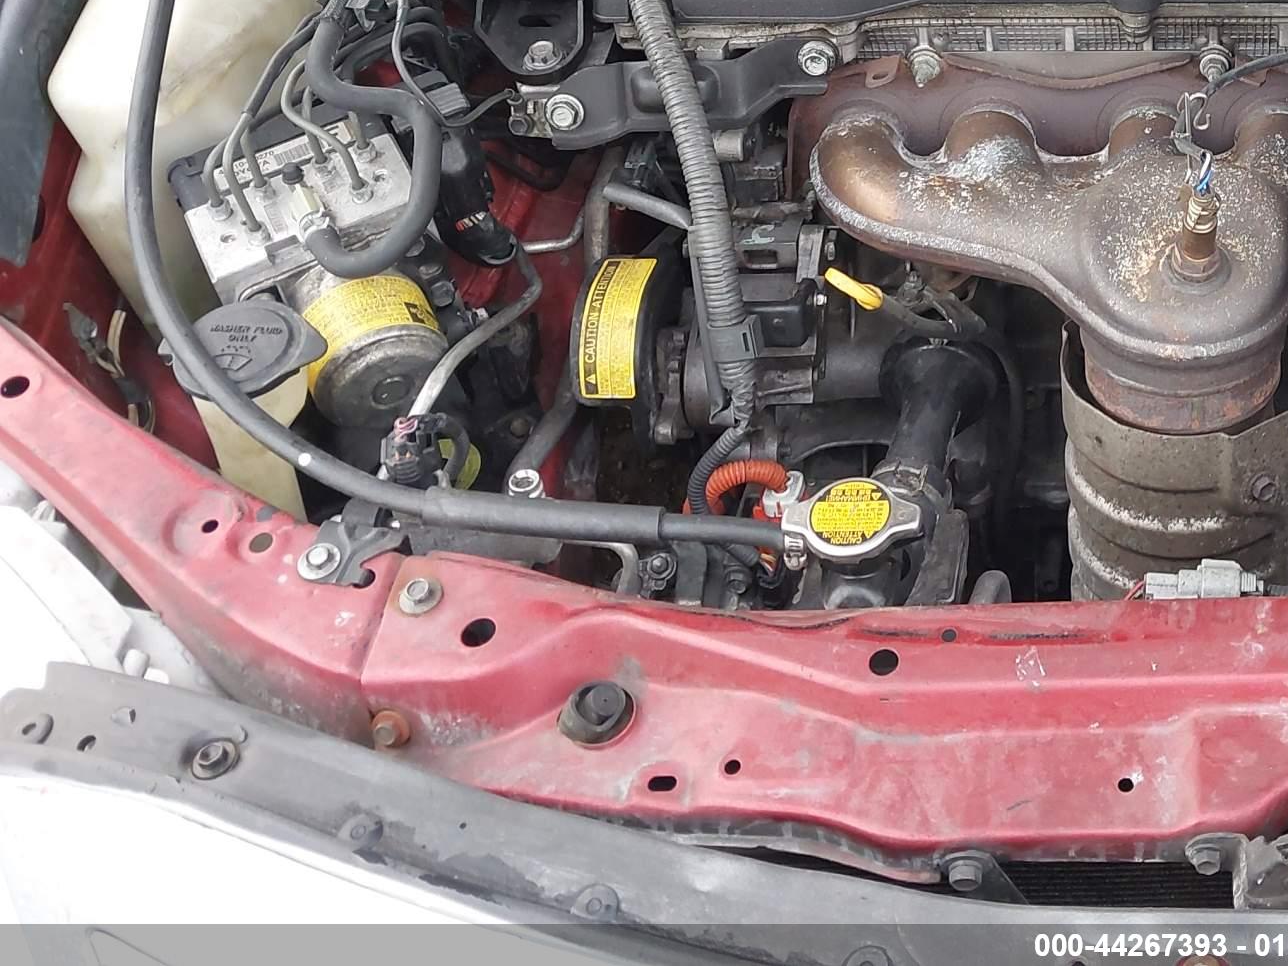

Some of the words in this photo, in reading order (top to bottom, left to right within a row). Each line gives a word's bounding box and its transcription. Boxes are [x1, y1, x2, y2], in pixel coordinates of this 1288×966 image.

[584, 309, 599, 364] CAUTION
[592, 264, 617, 308] ATTENTION
[830, 536, 863, 545] CAUTION
